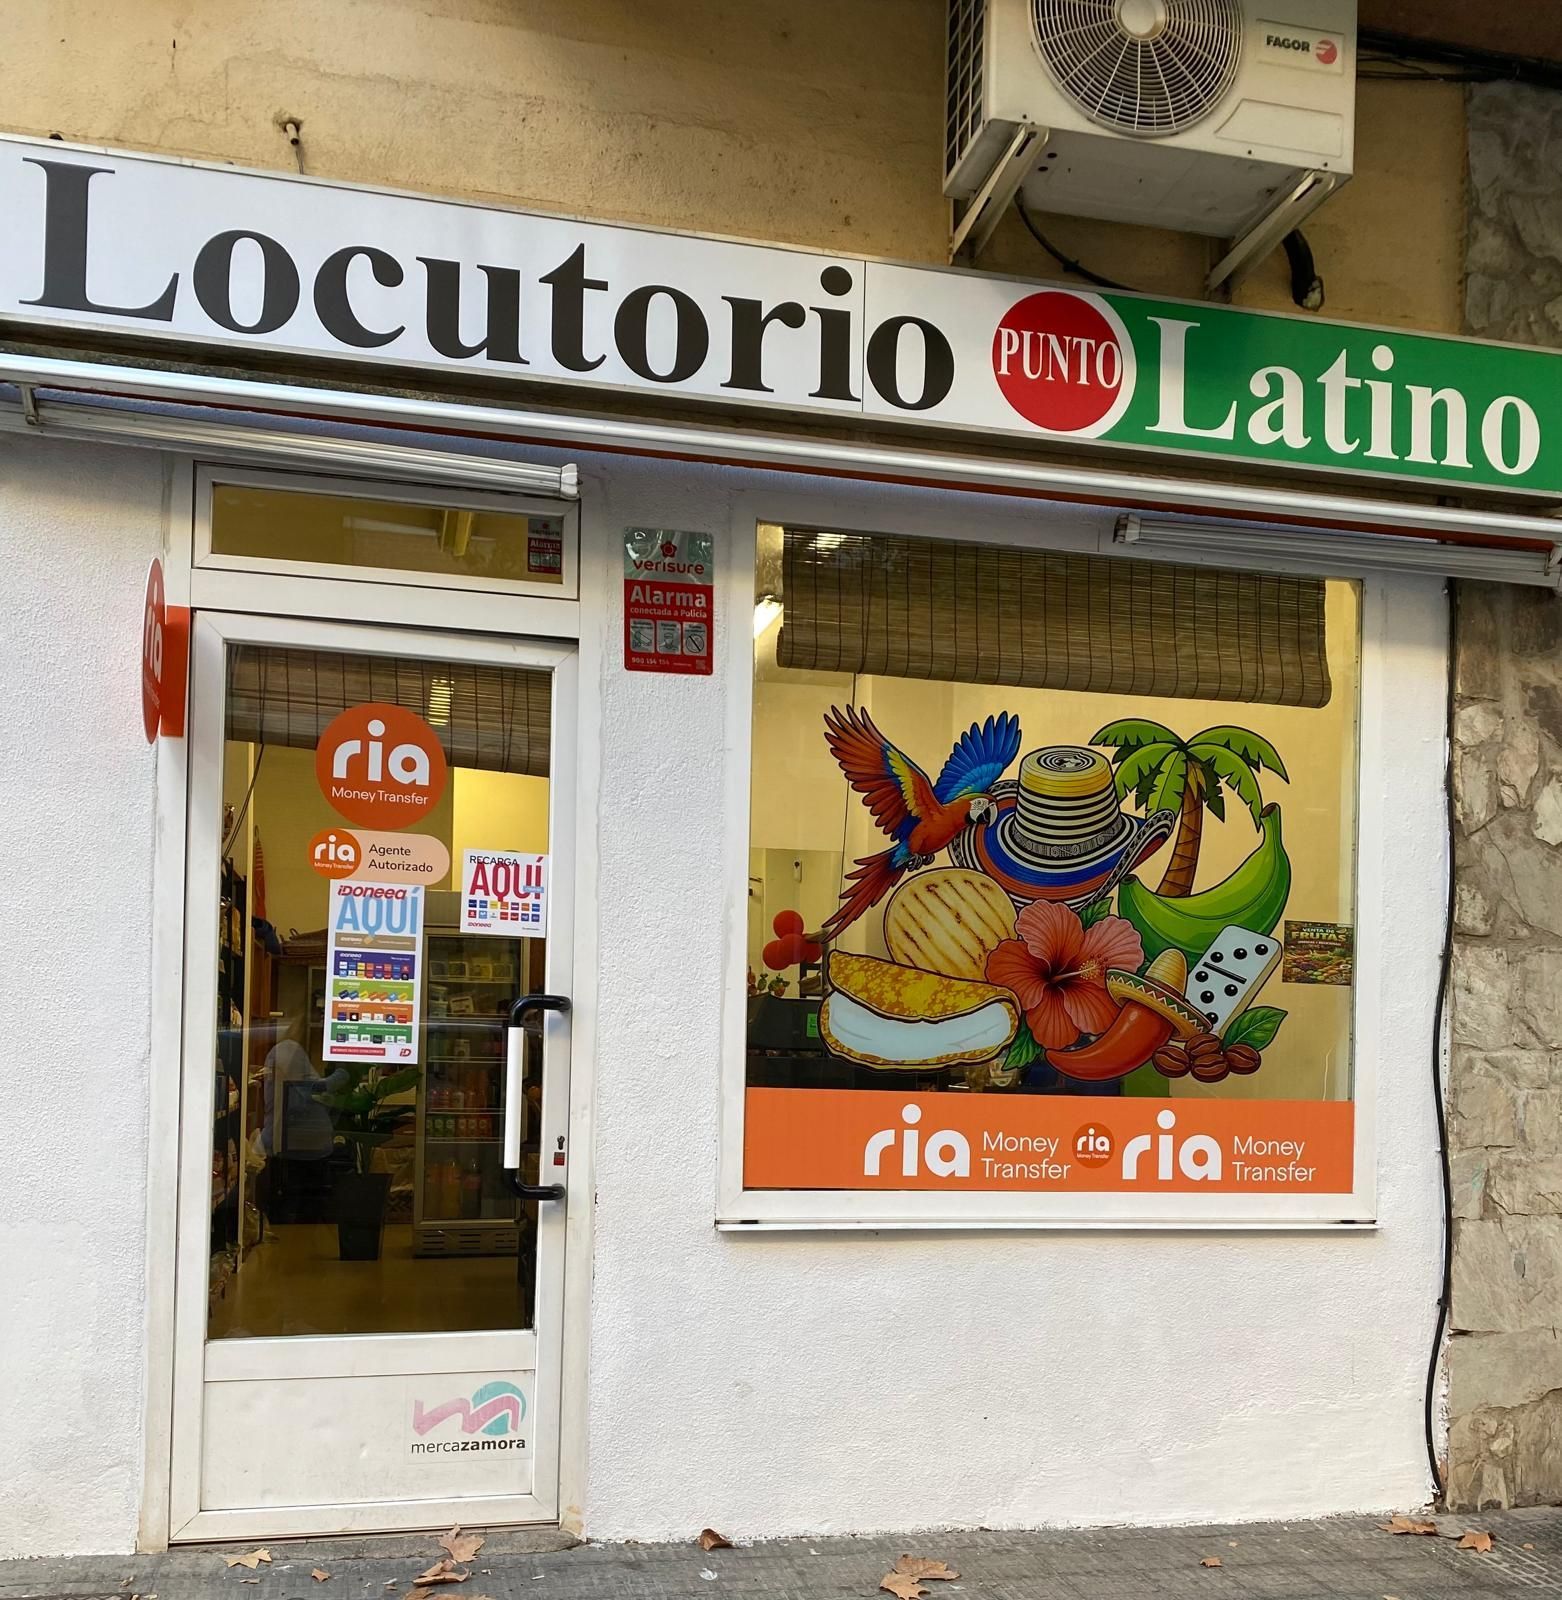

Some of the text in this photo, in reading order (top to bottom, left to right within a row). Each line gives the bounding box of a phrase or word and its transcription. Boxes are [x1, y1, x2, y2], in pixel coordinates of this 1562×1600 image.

[1266, 34, 1311, 52] FAGOR
[18, 156, 1541, 476] Locutorio PUNTO Latino
[633, 560, 705, 575] verisure
[630, 585, 707, 608] Alarma
[630, 607, 672, 616] conectada
[332, 719, 430, 786] ria
[332, 786, 429, 805] Money Transfer
[314, 834, 355, 862] ria
[368, 844, 411, 857] Agente
[368, 859, 433, 873] Autorizado
[469, 855, 519, 867] RECARGA
[469, 856, 544, 902] AQUÍ
[336, 886, 421, 937] AQUÍ
[1291, 931, 1347, 942] FRUTAS
[863, 1103, 970, 1177] ria
[982, 1130, 1059, 1157] Money
[1076, 1127, 1110, 1151] ria
[1122, 1109, 1223, 1181] ria
[1233, 1135, 1305, 1160] Money
[981, 1157, 1071, 1179] Transfer
[1232, 1161, 1316, 1183] Transfer
[411, 1438, 526, 1454] mercazamora
